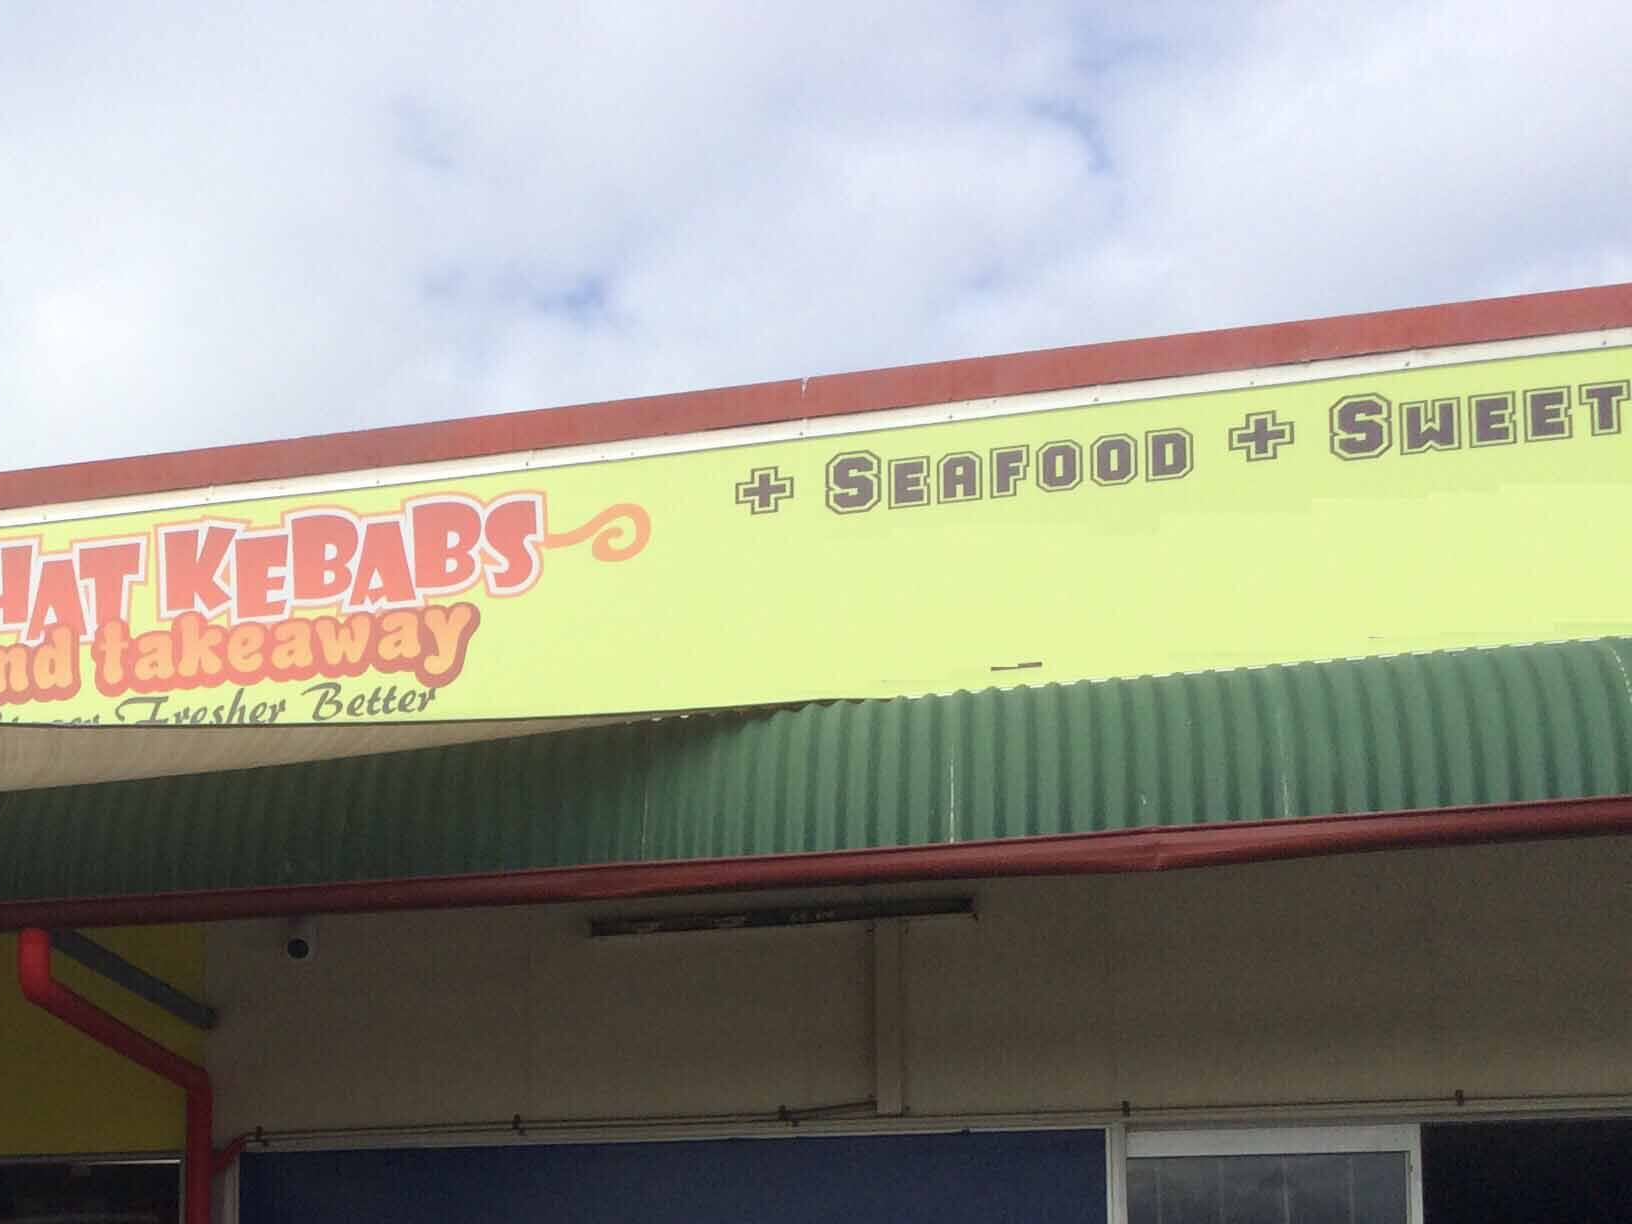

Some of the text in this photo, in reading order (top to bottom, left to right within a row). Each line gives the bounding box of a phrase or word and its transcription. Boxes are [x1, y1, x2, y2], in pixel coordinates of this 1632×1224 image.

[825, 427, 1193, 515] SEAFOOD
[154, 491, 546, 623] KEBABS
[90, 603, 480, 698] takeaway
[301, 682, 435, 722] Better
